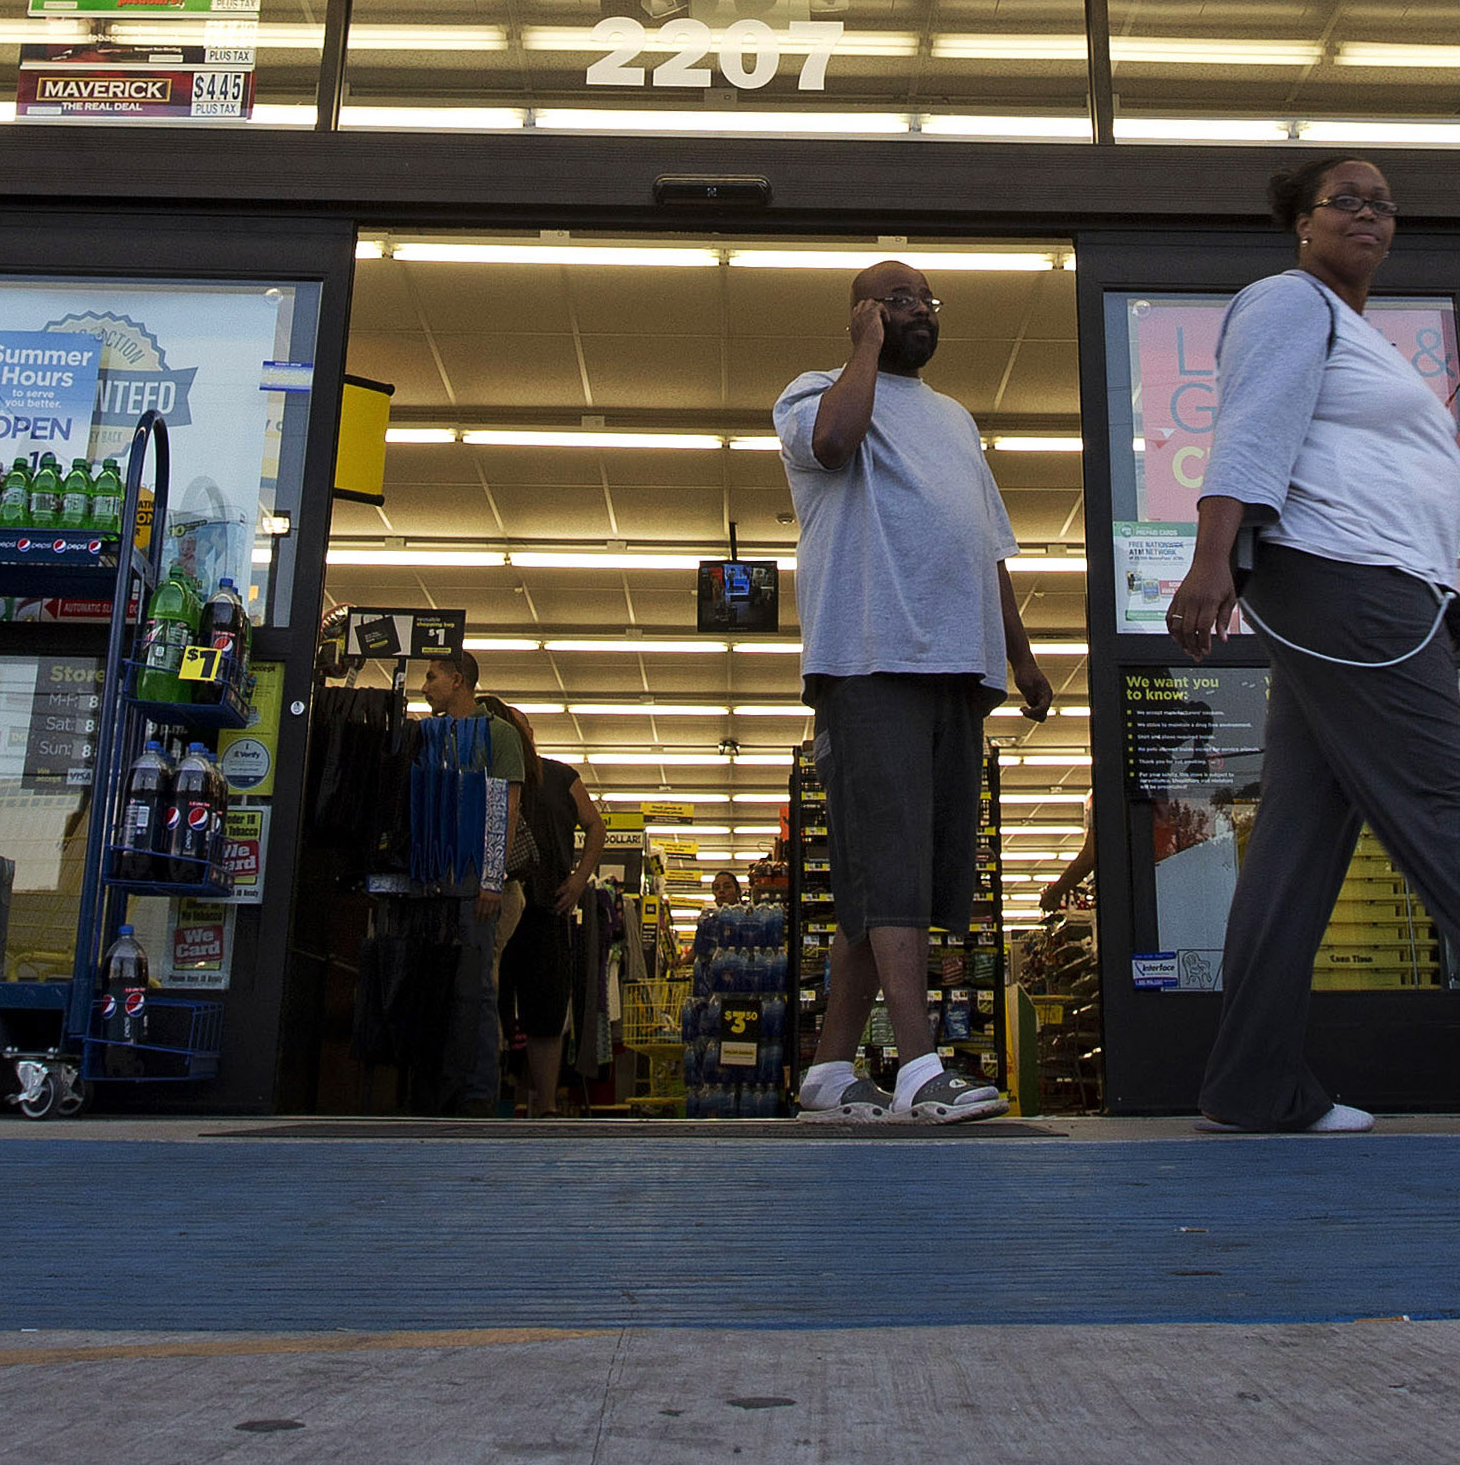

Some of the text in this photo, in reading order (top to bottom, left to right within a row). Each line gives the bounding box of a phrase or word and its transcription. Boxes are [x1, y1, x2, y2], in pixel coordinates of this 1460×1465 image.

[239, 0, 256, 9] TAX
[209, 50, 250, 61] PLUS TAX
[586, 16, 844, 91] 2207
[44, 80, 164, 99] MAVERICK
[194, 74, 241, 100] $4.45
[62, 102, 143, 112] THE REAL DEAL
[195, 104, 237, 115] PLUS TAX
[1, 366, 74, 388] Hours
[12, 389, 55, 399] to serve
[5, 399, 62, 409] you better.
[66, 542, 88, 550] pepsi
[63, 601, 101, 614] AUTOMATIC
[428, 628, 445, 646] $1
[186, 648, 217, 679] $1
[49, 665, 105, 683] Store
[1126, 676, 1219, 690] We want you
[89, 695, 98, 708] 8
[1126, 689, 1189, 701] to know:
[45, 716, 95, 732] Sat: 8
[40, 742, 91, 757] Sun: 8
[225, 814, 245, 825] nder
[229, 826, 258, 837] Tobacco
[224, 856, 256, 871] ard
[183, 928, 214, 943] We
[176, 942, 221, 958] Card
[1143, 963, 1175, 973] Interface
